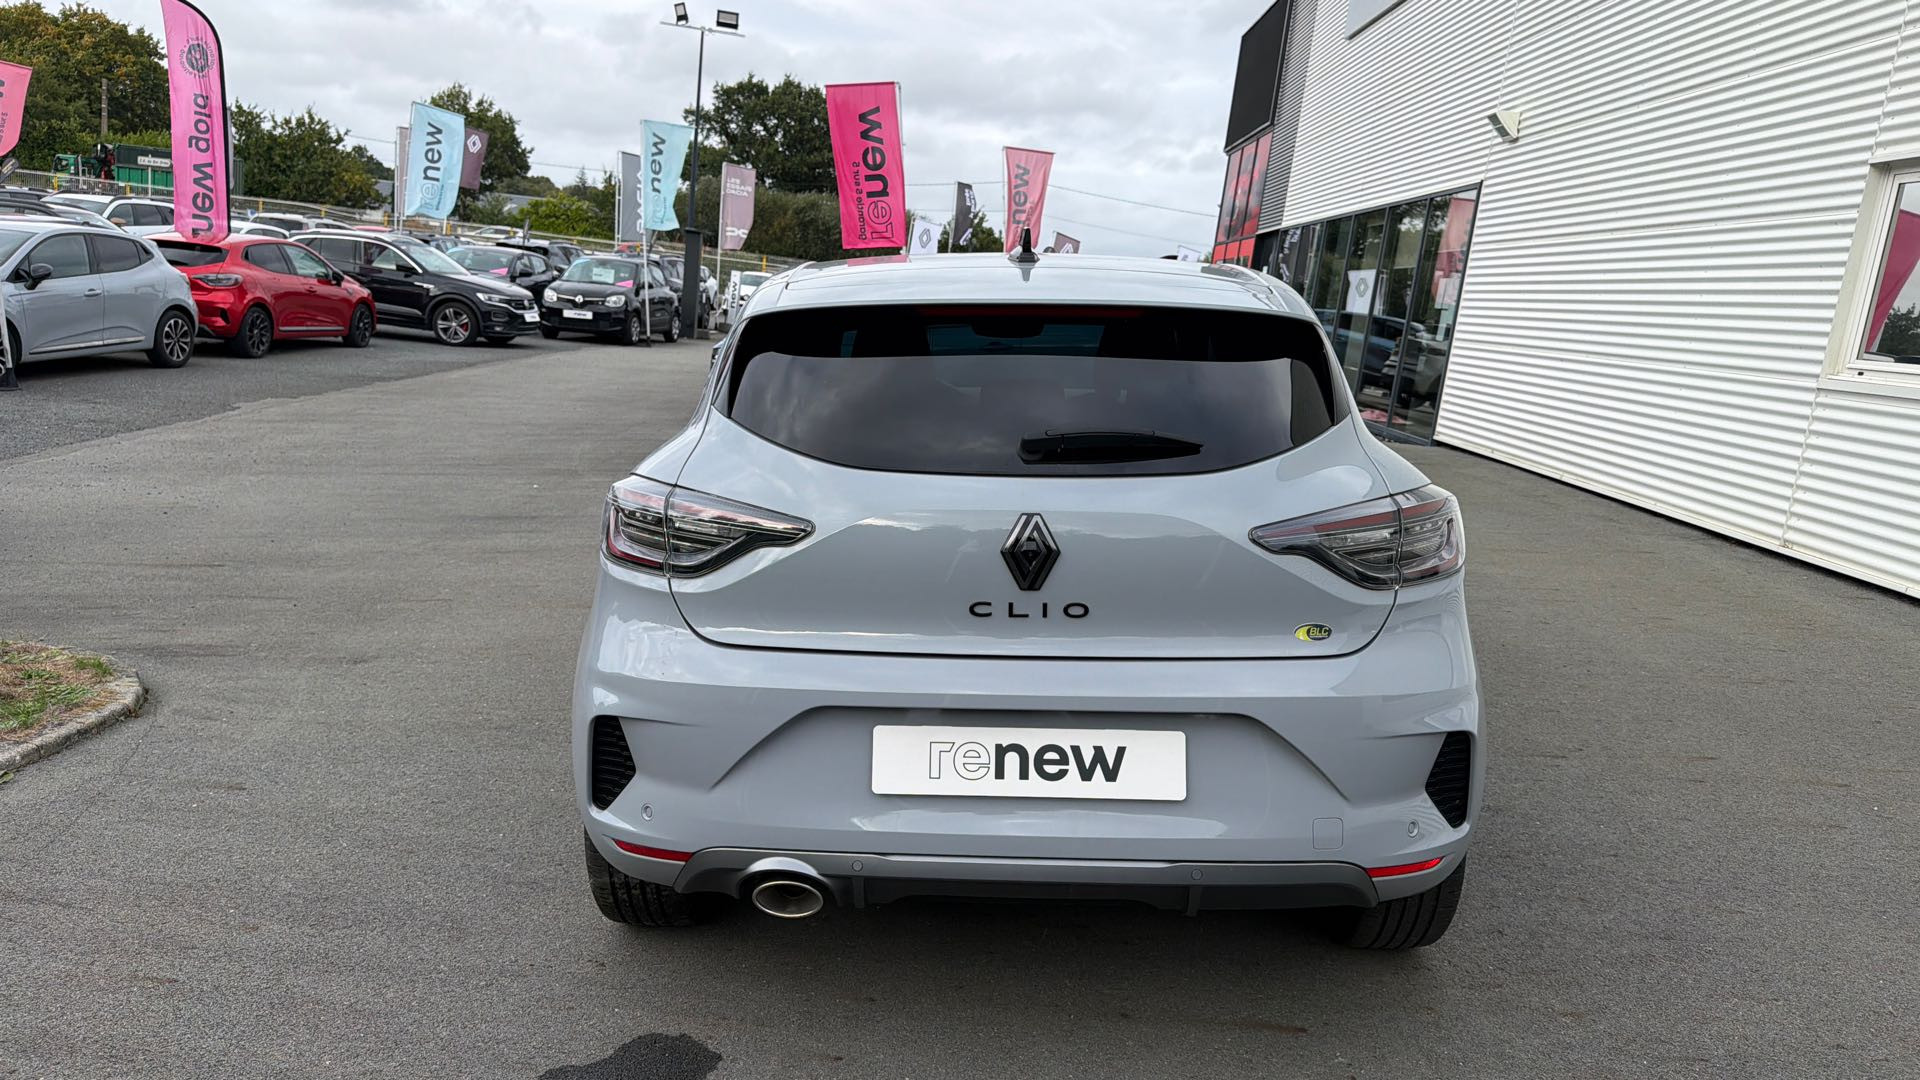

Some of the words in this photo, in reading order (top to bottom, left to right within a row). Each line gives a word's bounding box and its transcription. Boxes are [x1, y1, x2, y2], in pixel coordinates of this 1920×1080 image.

[420, 121, 443, 210] renew
[968, 600, 1090, 619] CLIO
[1309, 626, 1329, 637] BLC
[928, 741, 1126, 782] renew
